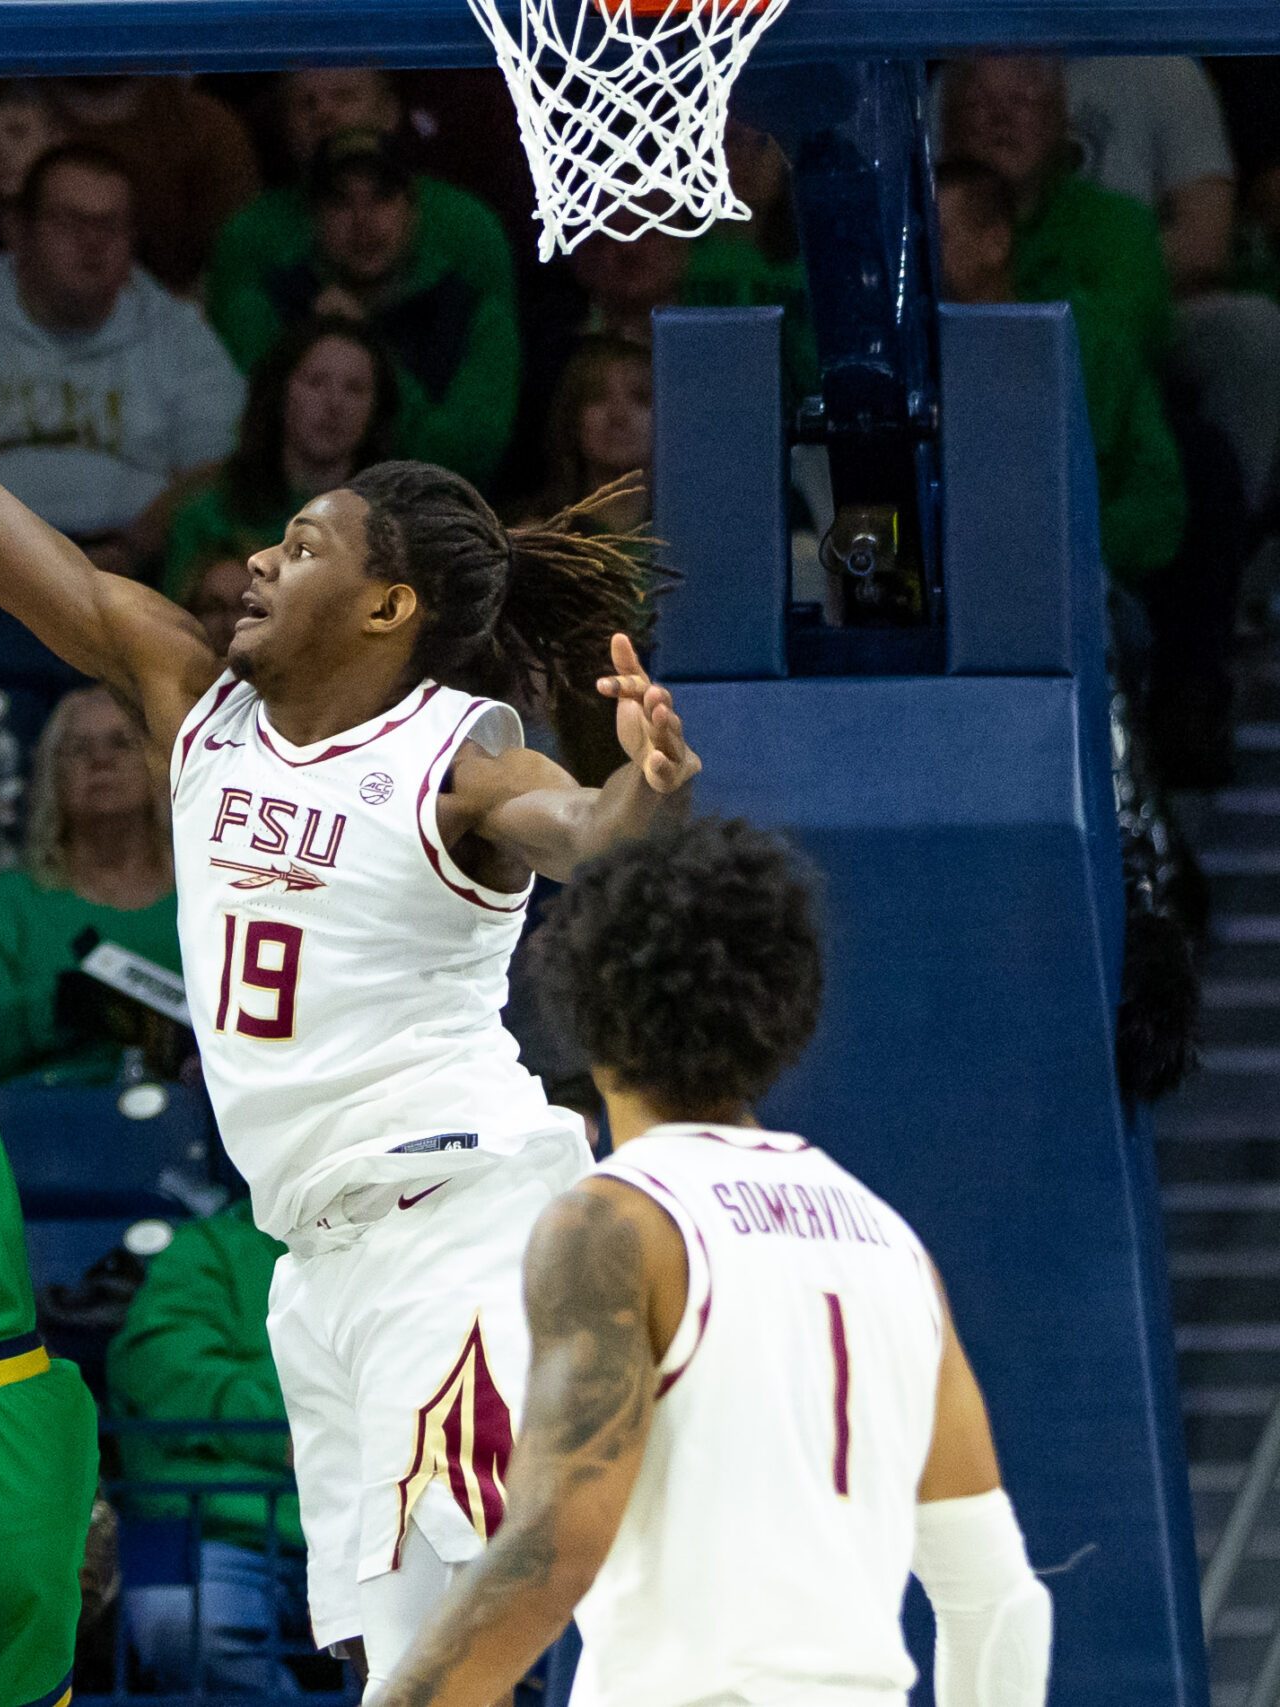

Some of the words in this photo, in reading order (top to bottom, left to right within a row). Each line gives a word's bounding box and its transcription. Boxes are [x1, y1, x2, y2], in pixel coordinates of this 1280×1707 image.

[209, 787, 347, 868] FSU
[214, 913, 306, 1042] 19
[712, 1180, 891, 1248] SOMERVILLE
[821, 1291, 851, 1500] 1
